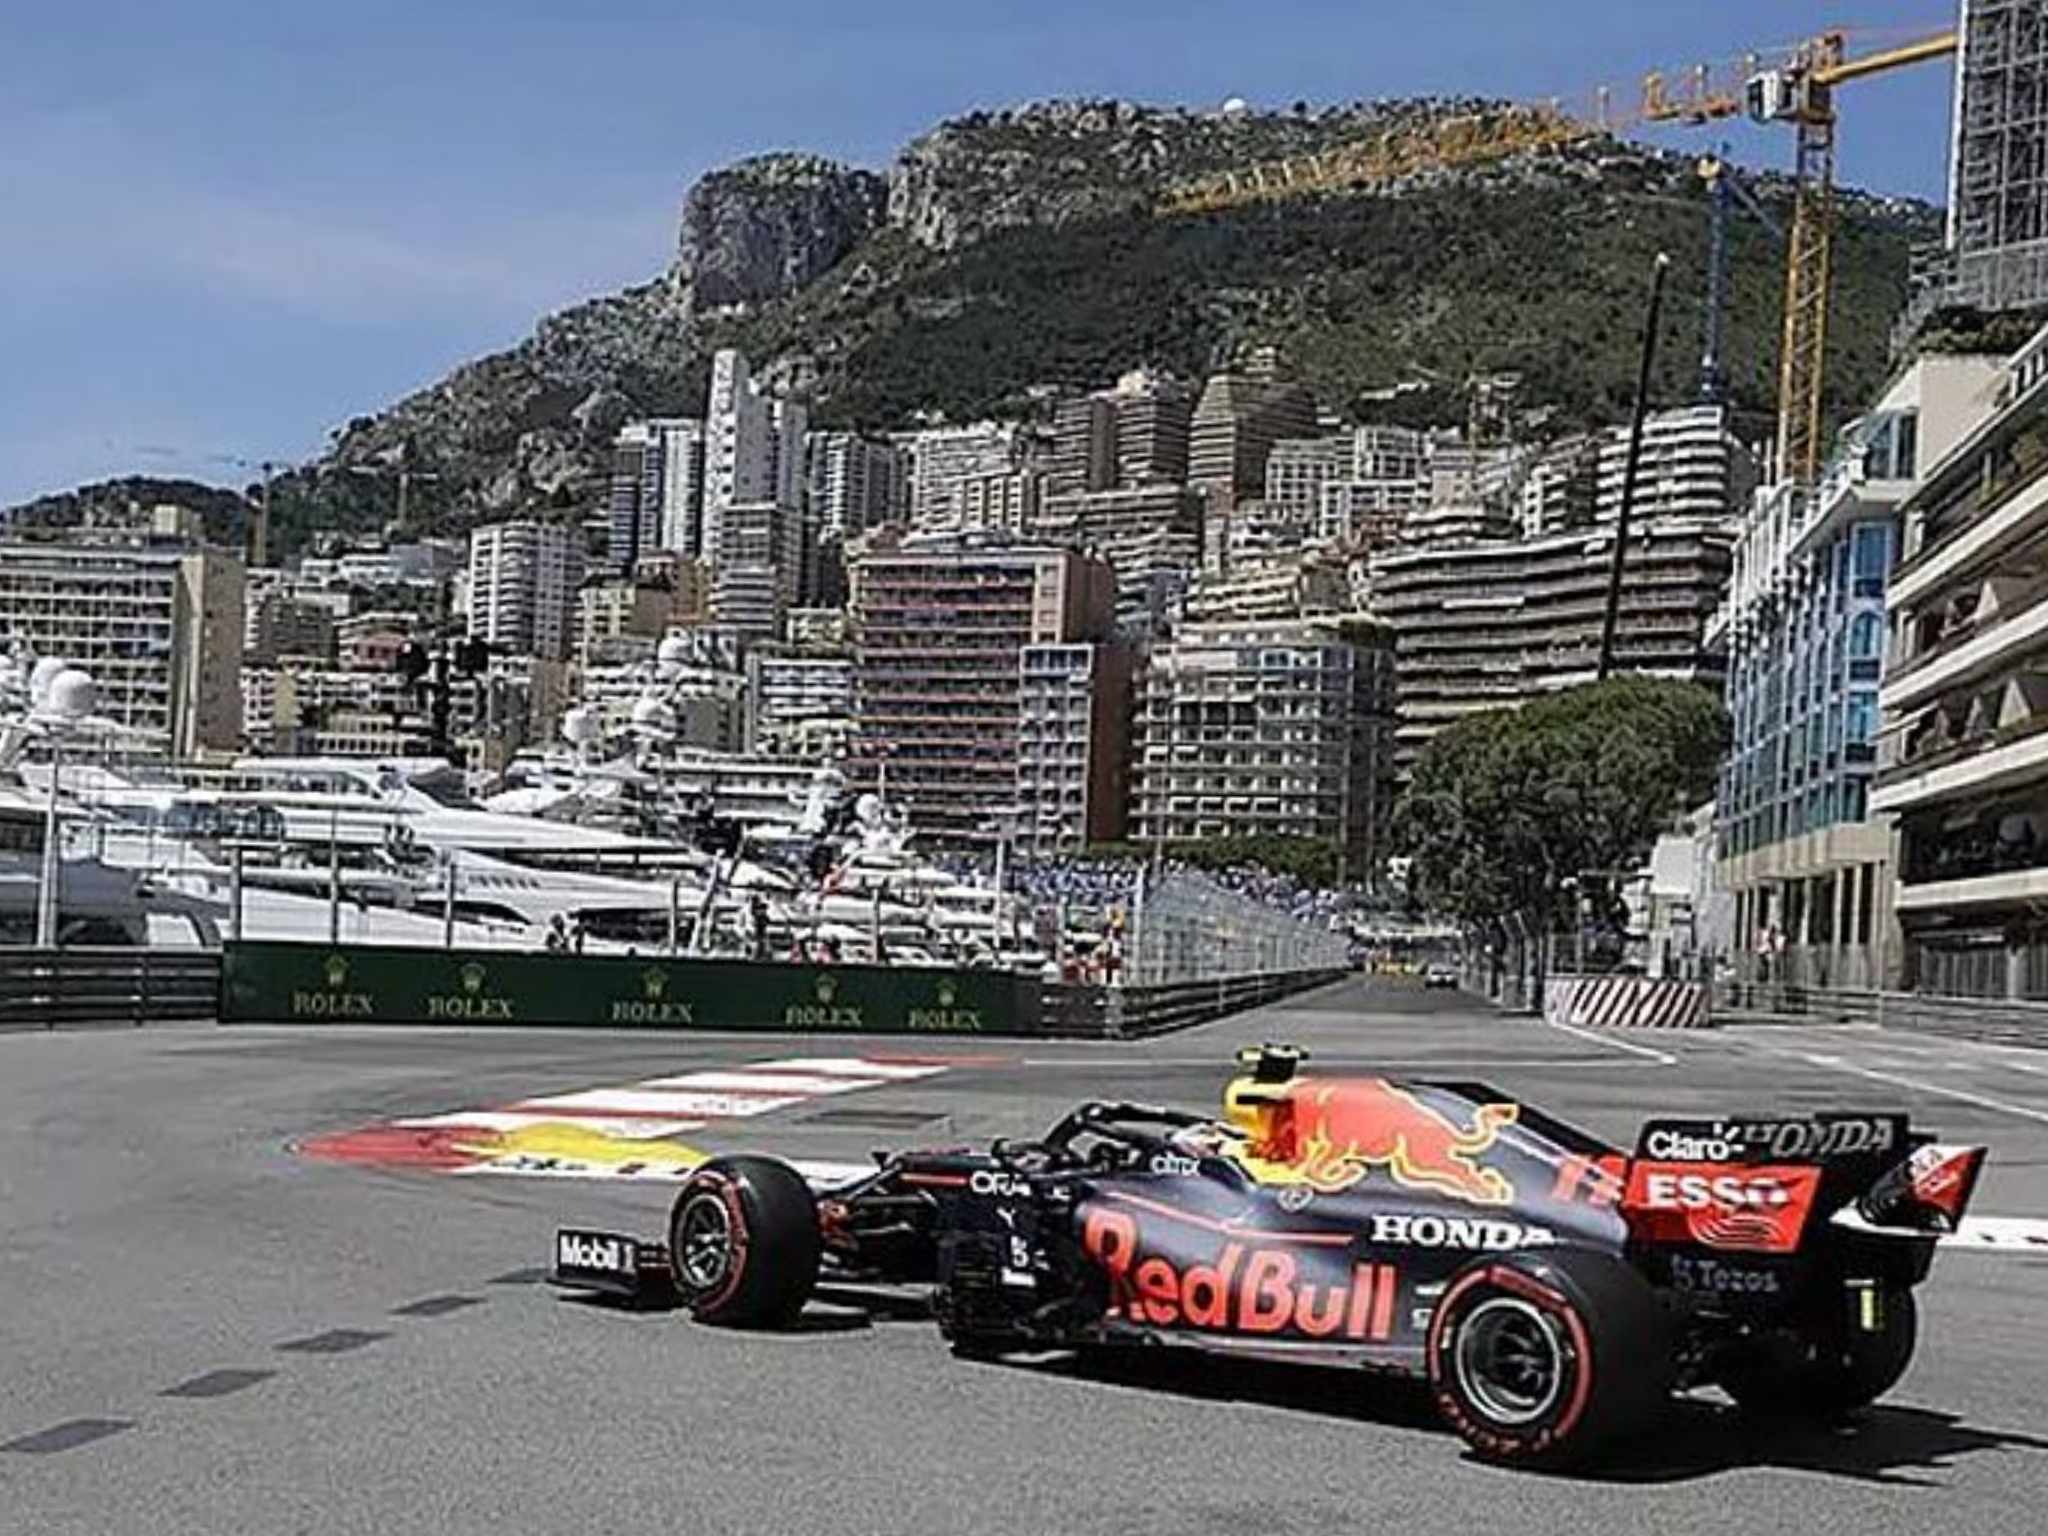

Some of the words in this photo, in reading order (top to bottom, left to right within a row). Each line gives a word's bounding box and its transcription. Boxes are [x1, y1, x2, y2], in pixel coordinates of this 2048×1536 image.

[292, 990, 375, 1016] ROLEX
[427, 995, 514, 1019] ROLEX
[611, 1001, 694, 1023] ROLEX
[784, 1005, 864, 1027] ROLEX
[908, 1009, 982, 1030] ROLEX
[1744, 1118, 1894, 1157] HONDA
[1370, 1214, 1560, 1252] HONDA
[560, 1234, 619, 1270] Mobil
